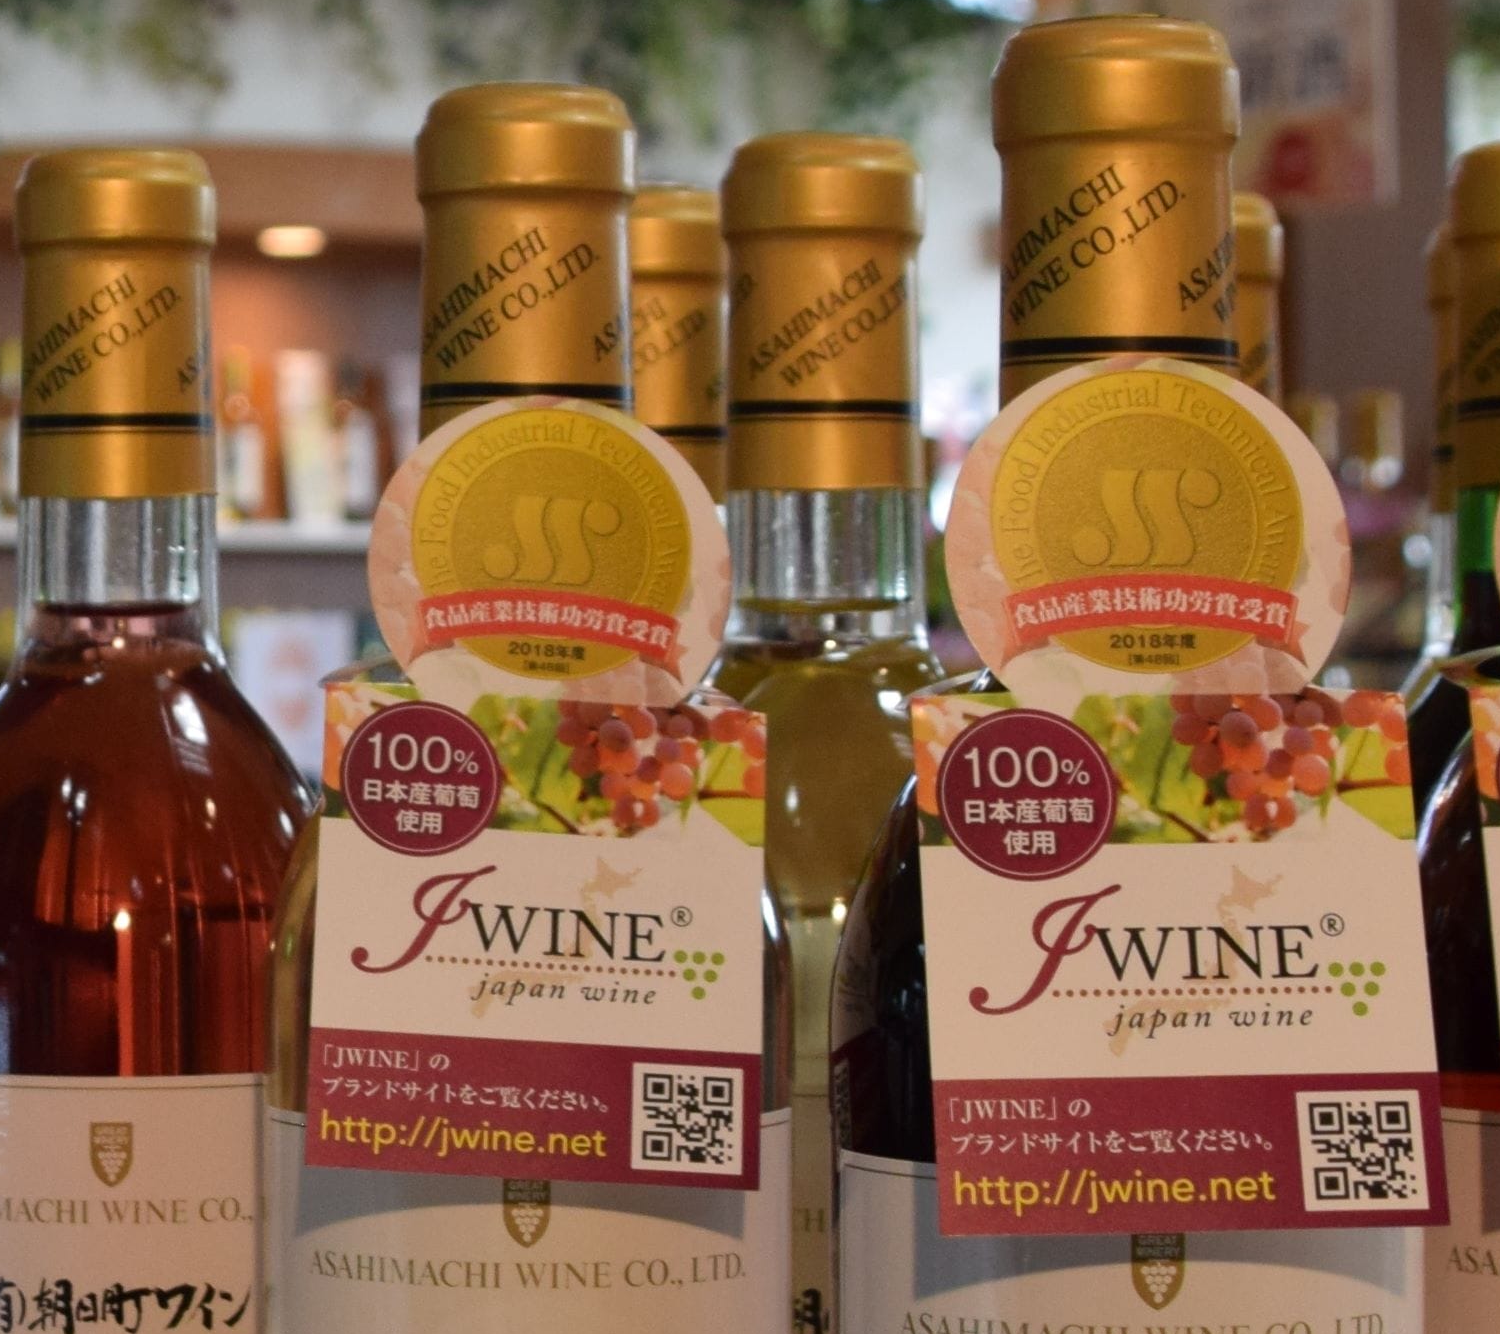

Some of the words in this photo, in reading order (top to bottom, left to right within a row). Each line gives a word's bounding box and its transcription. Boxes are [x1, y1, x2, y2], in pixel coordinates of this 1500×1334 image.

[1008, 256, 1070, 326] WINE
[436, 308, 501, 370] WINE
[748, 257, 883, 383] ASAHIMACHI
[34, 346, 93, 405] WINE
[780, 330, 843, 389] WINE
[1109, 633, 1197, 650] 2018年度
[367, 731, 480, 776] 100%
[963, 746, 1091, 790] 100%
[361, 779, 482, 810] 日本産葡萄
[963, 798, 1095, 826] 日本産葡萄
[395, 811, 443, 835] 使用
[1003, 830, 1057, 856] 使用
[471, 972, 567, 1007] japan
[580, 984, 658, 1006] wine
[1107, 1003, 1213, 1039] japan
[1228, 1007, 1314, 1029] wine
[321, 1076, 611, 1115] ブランドサイトをご覧ください。
[320, 1109, 609, 1159] http://jwine.net
[950, 1128, 1276, 1157] ブランドサイトをご覧ください。
[101, 1198, 189, 1224] WINE
[953, 1169, 1277, 1218] http://jwine.net
[311, 1250, 501, 1289] ASAHIMACHI
[515, 1261, 613, 1289] WINE
[691, 1252, 747, 1283] LTD.
